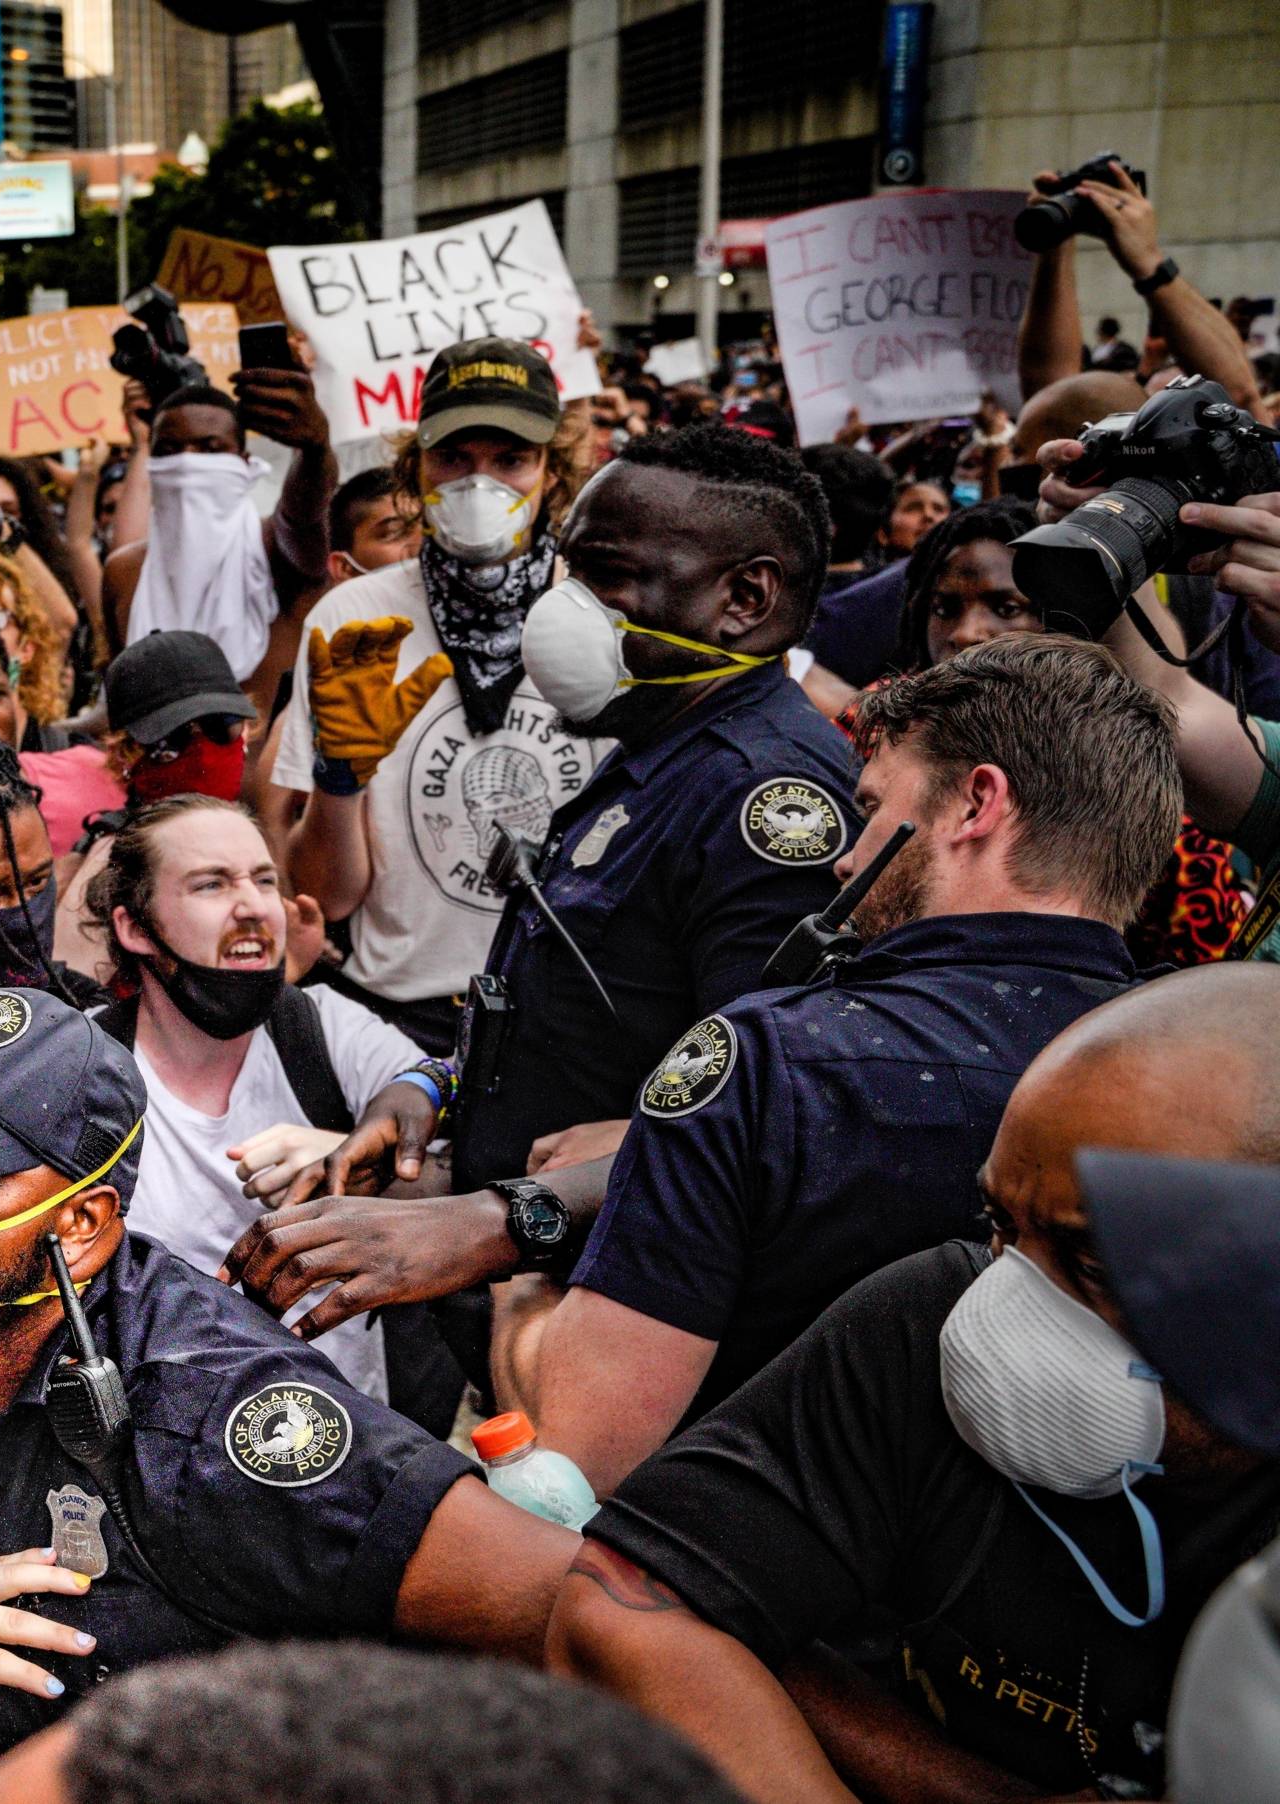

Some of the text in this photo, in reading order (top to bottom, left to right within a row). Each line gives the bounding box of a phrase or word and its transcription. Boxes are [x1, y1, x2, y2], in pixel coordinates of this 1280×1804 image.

[300, 224, 547, 317] BLACK
[775, 224, 838, 284] I
[804, 272, 961, 334] GEORGE
[364, 291, 548, 363] LIVES
[8, 354, 64, 388] NOT
[796, 342, 847, 399] I
[1122, 445, 1156, 456] Nikon
[421, 735, 466, 798] GAZA
[552, 743, 582, 792] FOR
[749, 800, 765, 830] CITY
[762, 786, 782, 802] OF
[786, 785, 838, 828] ATLANTA
[766, 840, 830, 858] POLICE
[1244, 904, 1273, 947] Nikon
[0, 997, 23, 1034] ATLANTA
[52, 1380, 81, 1388] MOTOROLA
[235, 1390, 313, 1473] CITY OF ATLANTA
[296, 1417, 341, 1476] POLICE
[58, 1495, 88, 1508] ATLANTA
[63, 1510, 86, 1521] POLICE
[959, 1655, 985, 1690] R.
